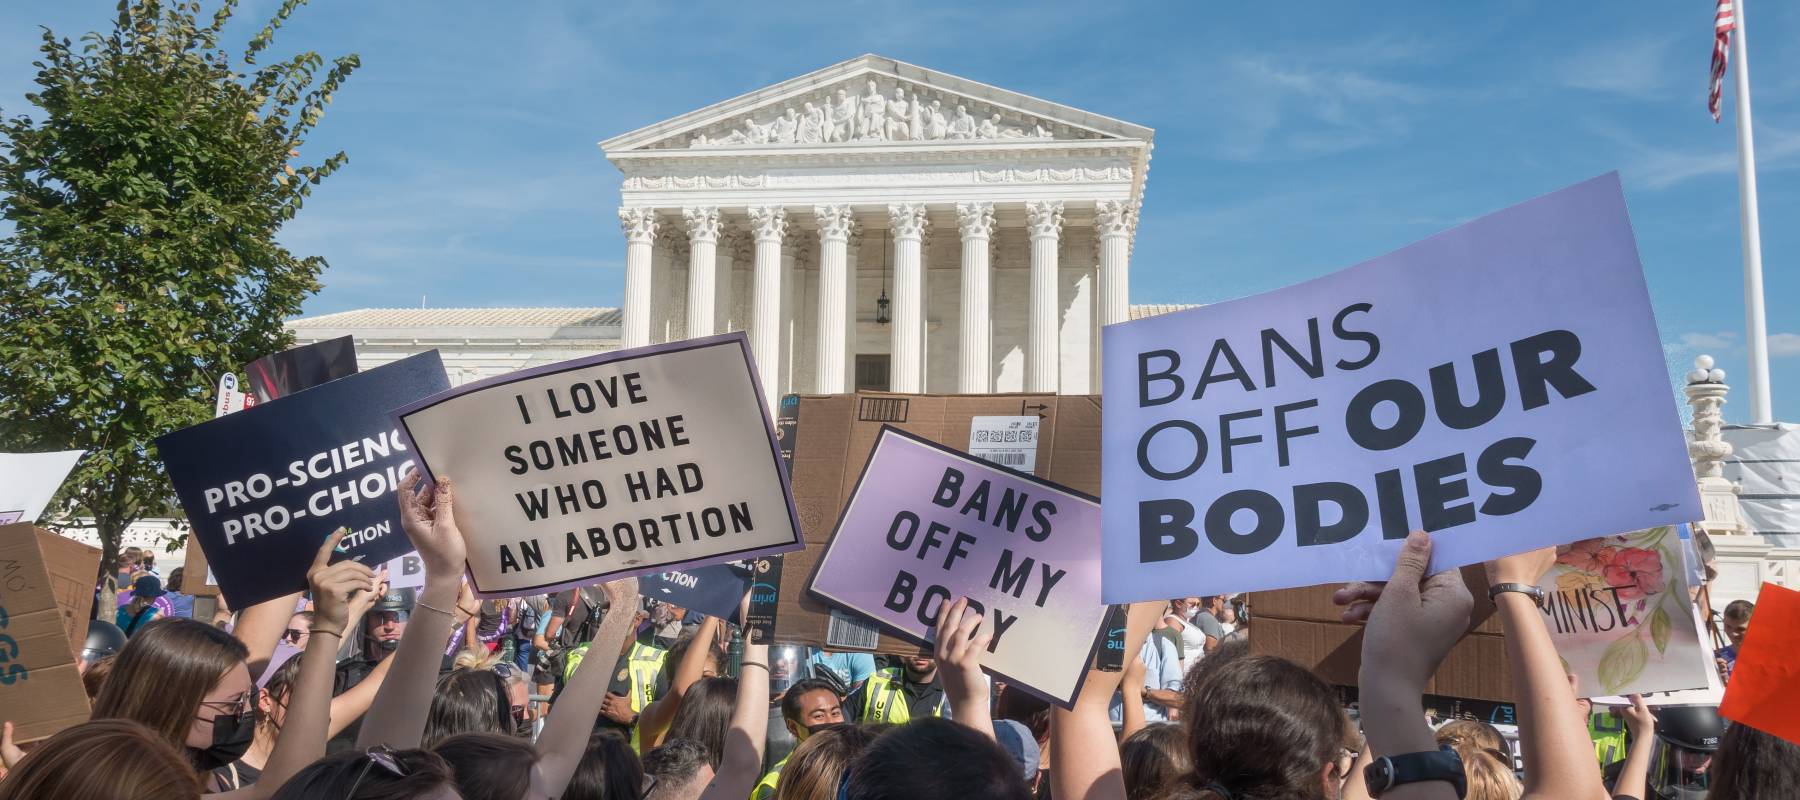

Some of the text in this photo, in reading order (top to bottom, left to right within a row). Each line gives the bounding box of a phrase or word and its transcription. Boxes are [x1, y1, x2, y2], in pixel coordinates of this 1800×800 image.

[1137, 302, 1381, 408] BANS
[516, 372, 647, 424] I LOVE
[1136, 329, 1597, 480] OFF OUR
[504, 414, 690, 475] SOMEONE
[515, 462, 704, 521] WHO HAD
[932, 467, 1058, 542] BANS
[1139, 436, 1543, 563] BODIES
[337, 520, 391, 551] CTION
[500, 501, 754, 574] AN ABORTION
[886, 510, 1067, 608] OFF MY
[662, 570, 698, 589] CTION
